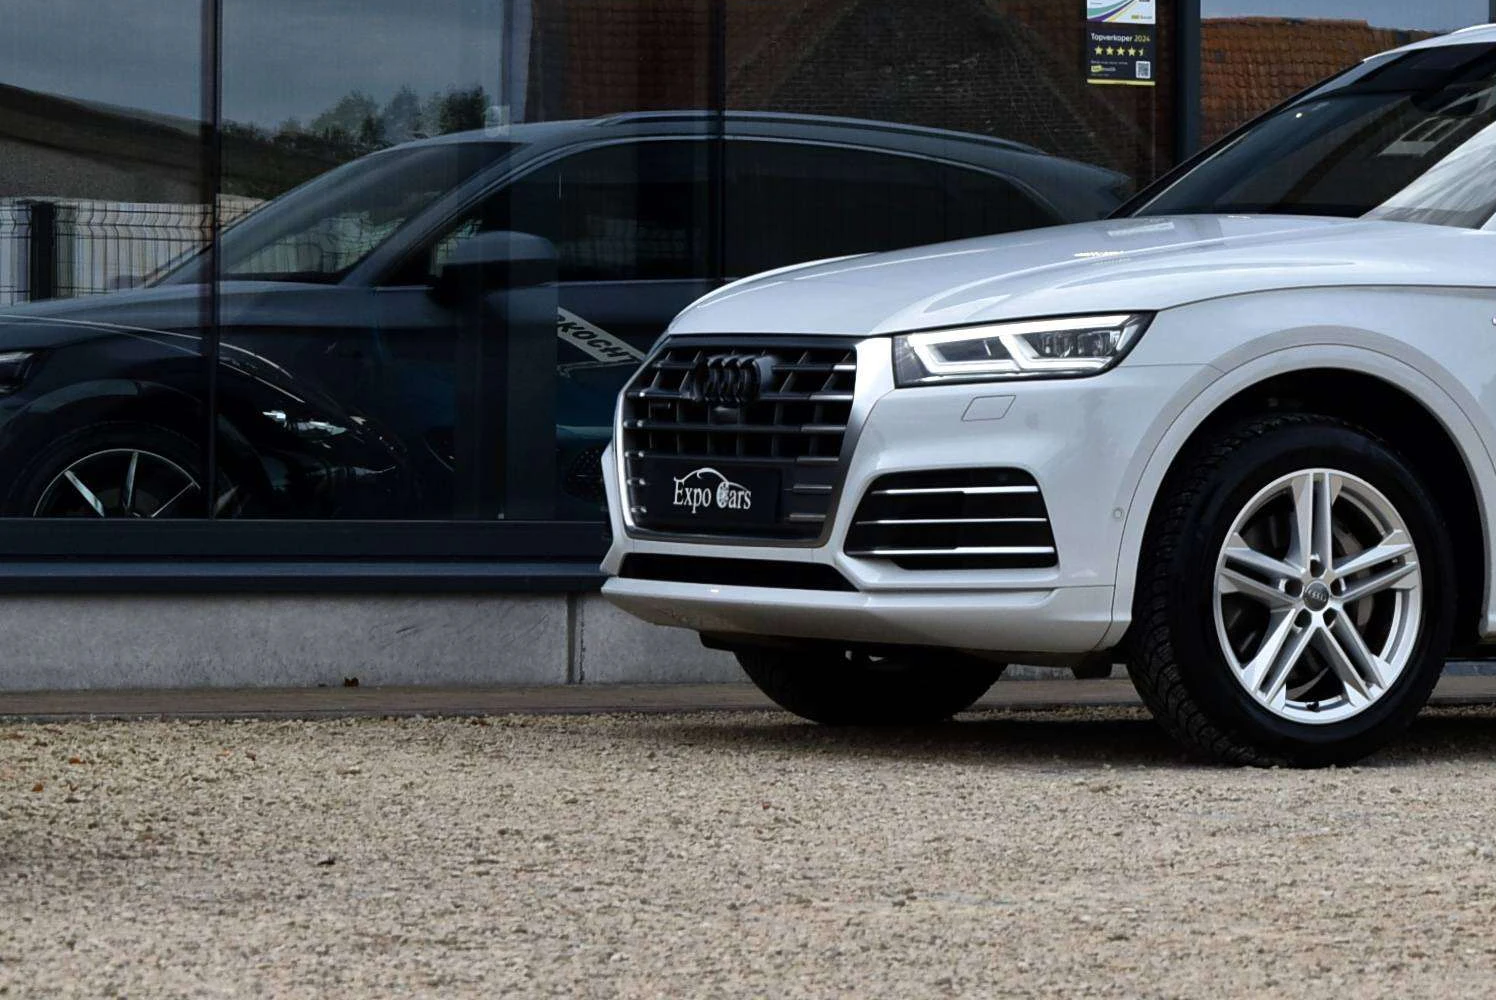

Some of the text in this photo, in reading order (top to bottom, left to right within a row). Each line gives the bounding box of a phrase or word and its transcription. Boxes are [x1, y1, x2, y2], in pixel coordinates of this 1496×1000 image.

[1091, 33, 1133, 43] Topverkoper
[673, 476, 752, 514] Expo Cars
